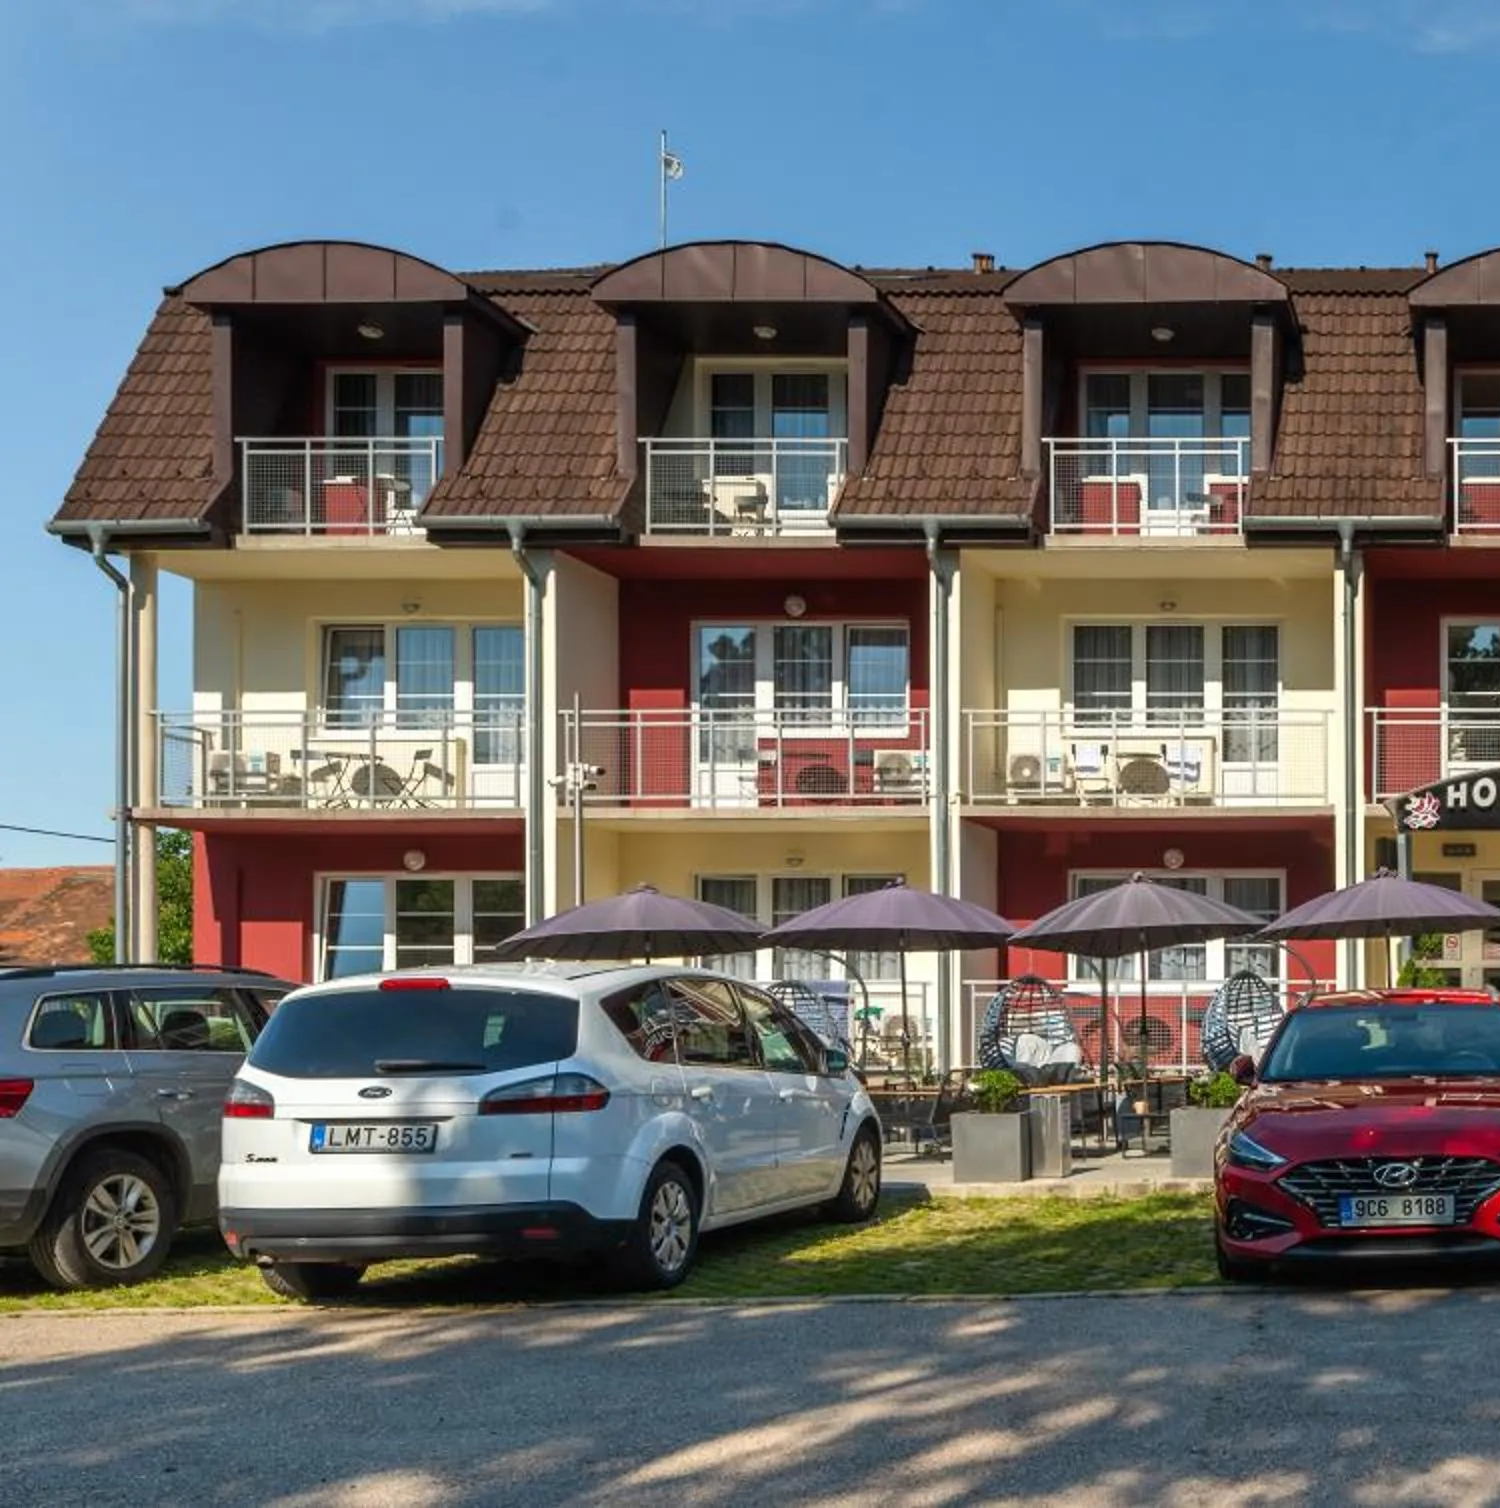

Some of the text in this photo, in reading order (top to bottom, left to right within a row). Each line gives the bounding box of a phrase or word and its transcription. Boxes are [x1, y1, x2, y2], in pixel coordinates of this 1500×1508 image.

[328, 1127, 428, 1147] LMT-855
[1355, 1197, 1446, 1217] 9C6 8188
